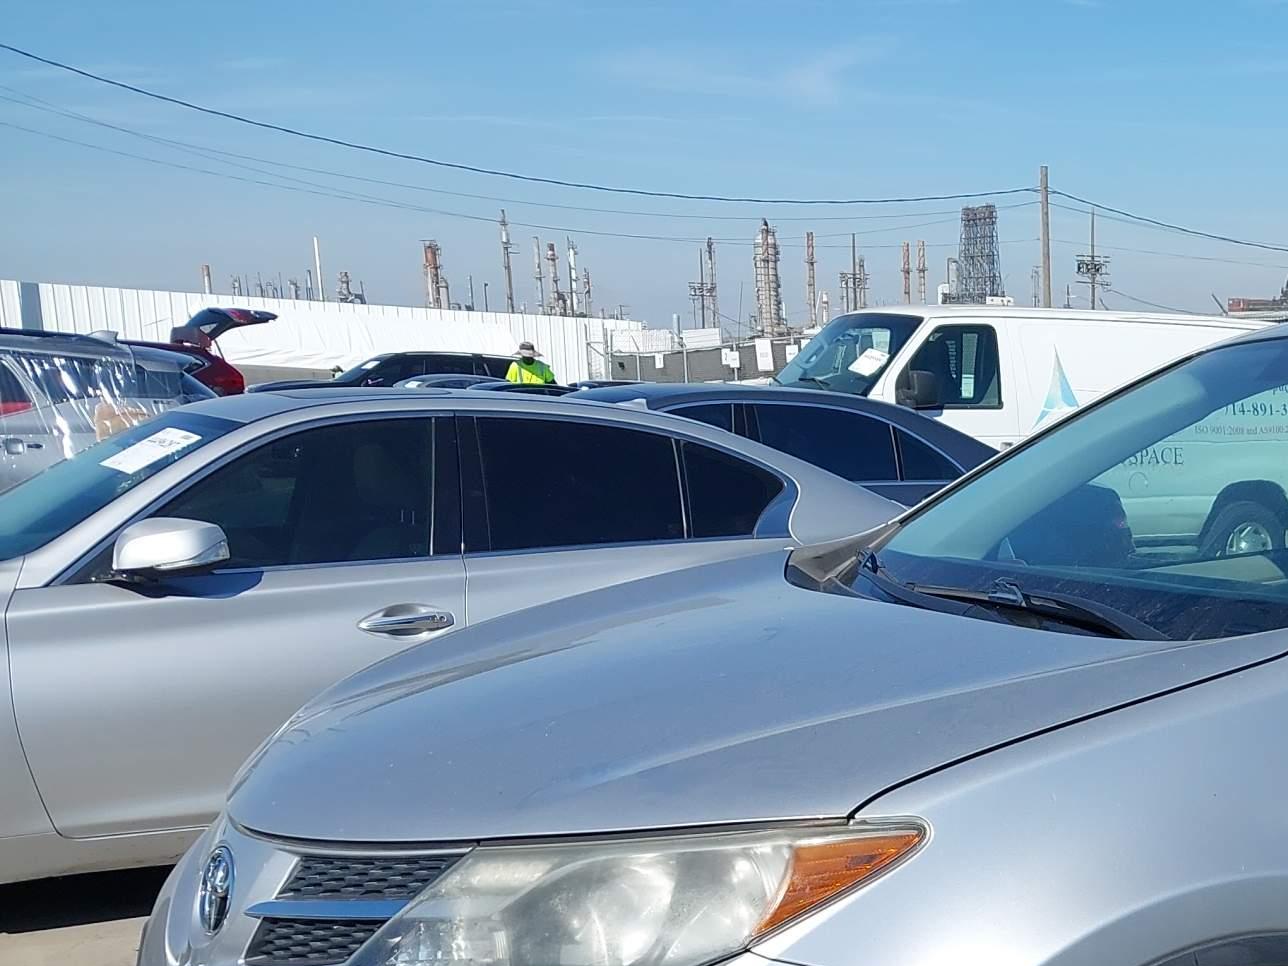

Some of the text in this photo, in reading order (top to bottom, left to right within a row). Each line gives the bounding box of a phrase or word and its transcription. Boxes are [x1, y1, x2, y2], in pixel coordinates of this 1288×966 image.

[1194, 425, 1209, 434] ISO
[1246, 425, 1258, 434] and
[1122, 447, 1184, 465] SPACE
